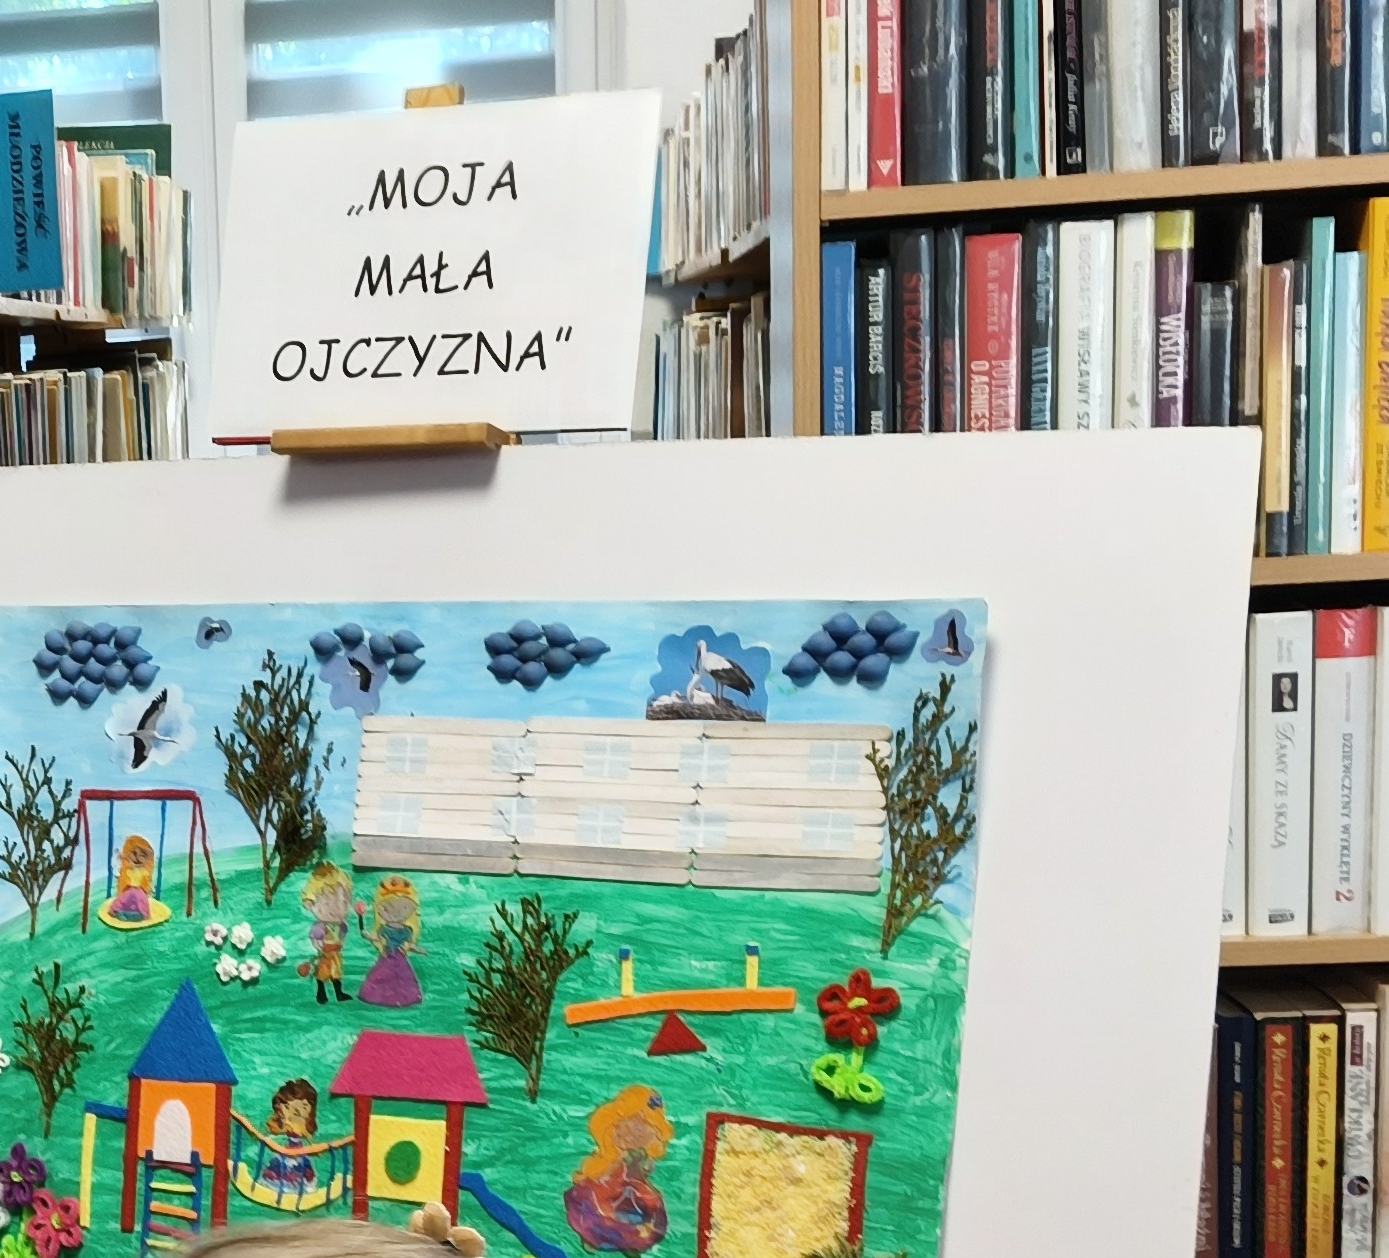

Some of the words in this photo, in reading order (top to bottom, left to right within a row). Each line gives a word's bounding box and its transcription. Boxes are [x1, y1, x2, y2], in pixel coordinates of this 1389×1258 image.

[5, 110, 29, 273] MŁODZIEŻOWA
[29, 142, 51, 240] POWIEŚĆ
[346, 160, 518, 217] „MOJA
[353, 250, 494, 298] MAŁA
[1077, 325, 1091, 405] WISŁAWY
[991, 359, 1016, 433] POTARGA
[1275, 722, 1296, 774] DAMY
[1339, 733, 1354, 819] DZIEWCZYNY
[1274, 780, 1289, 796] ZE
[1338, 824, 1352, 885] WYKLĘTE
[1335, 888, 1355, 903] 2
